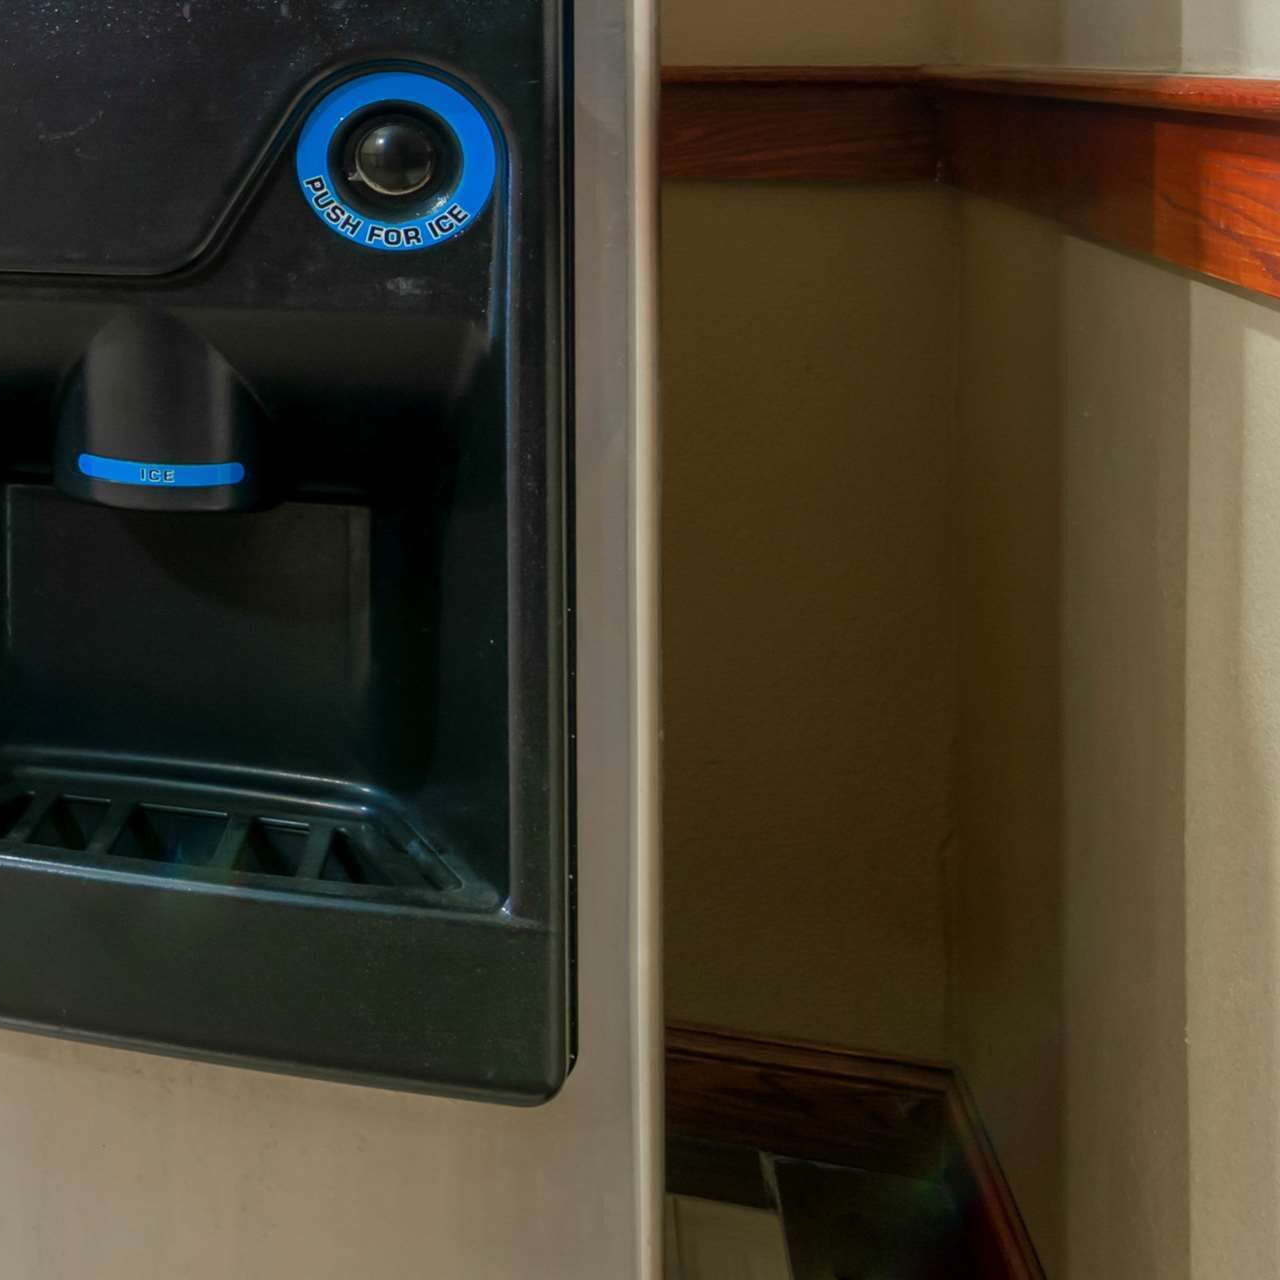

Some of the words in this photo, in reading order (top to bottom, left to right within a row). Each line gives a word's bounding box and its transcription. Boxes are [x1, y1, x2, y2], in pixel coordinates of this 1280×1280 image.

[303, 175, 362, 237] PUSH
[365, 224, 424, 247] FOR
[425, 202, 471, 240] ICE
[139, 468, 176, 483] ICE
